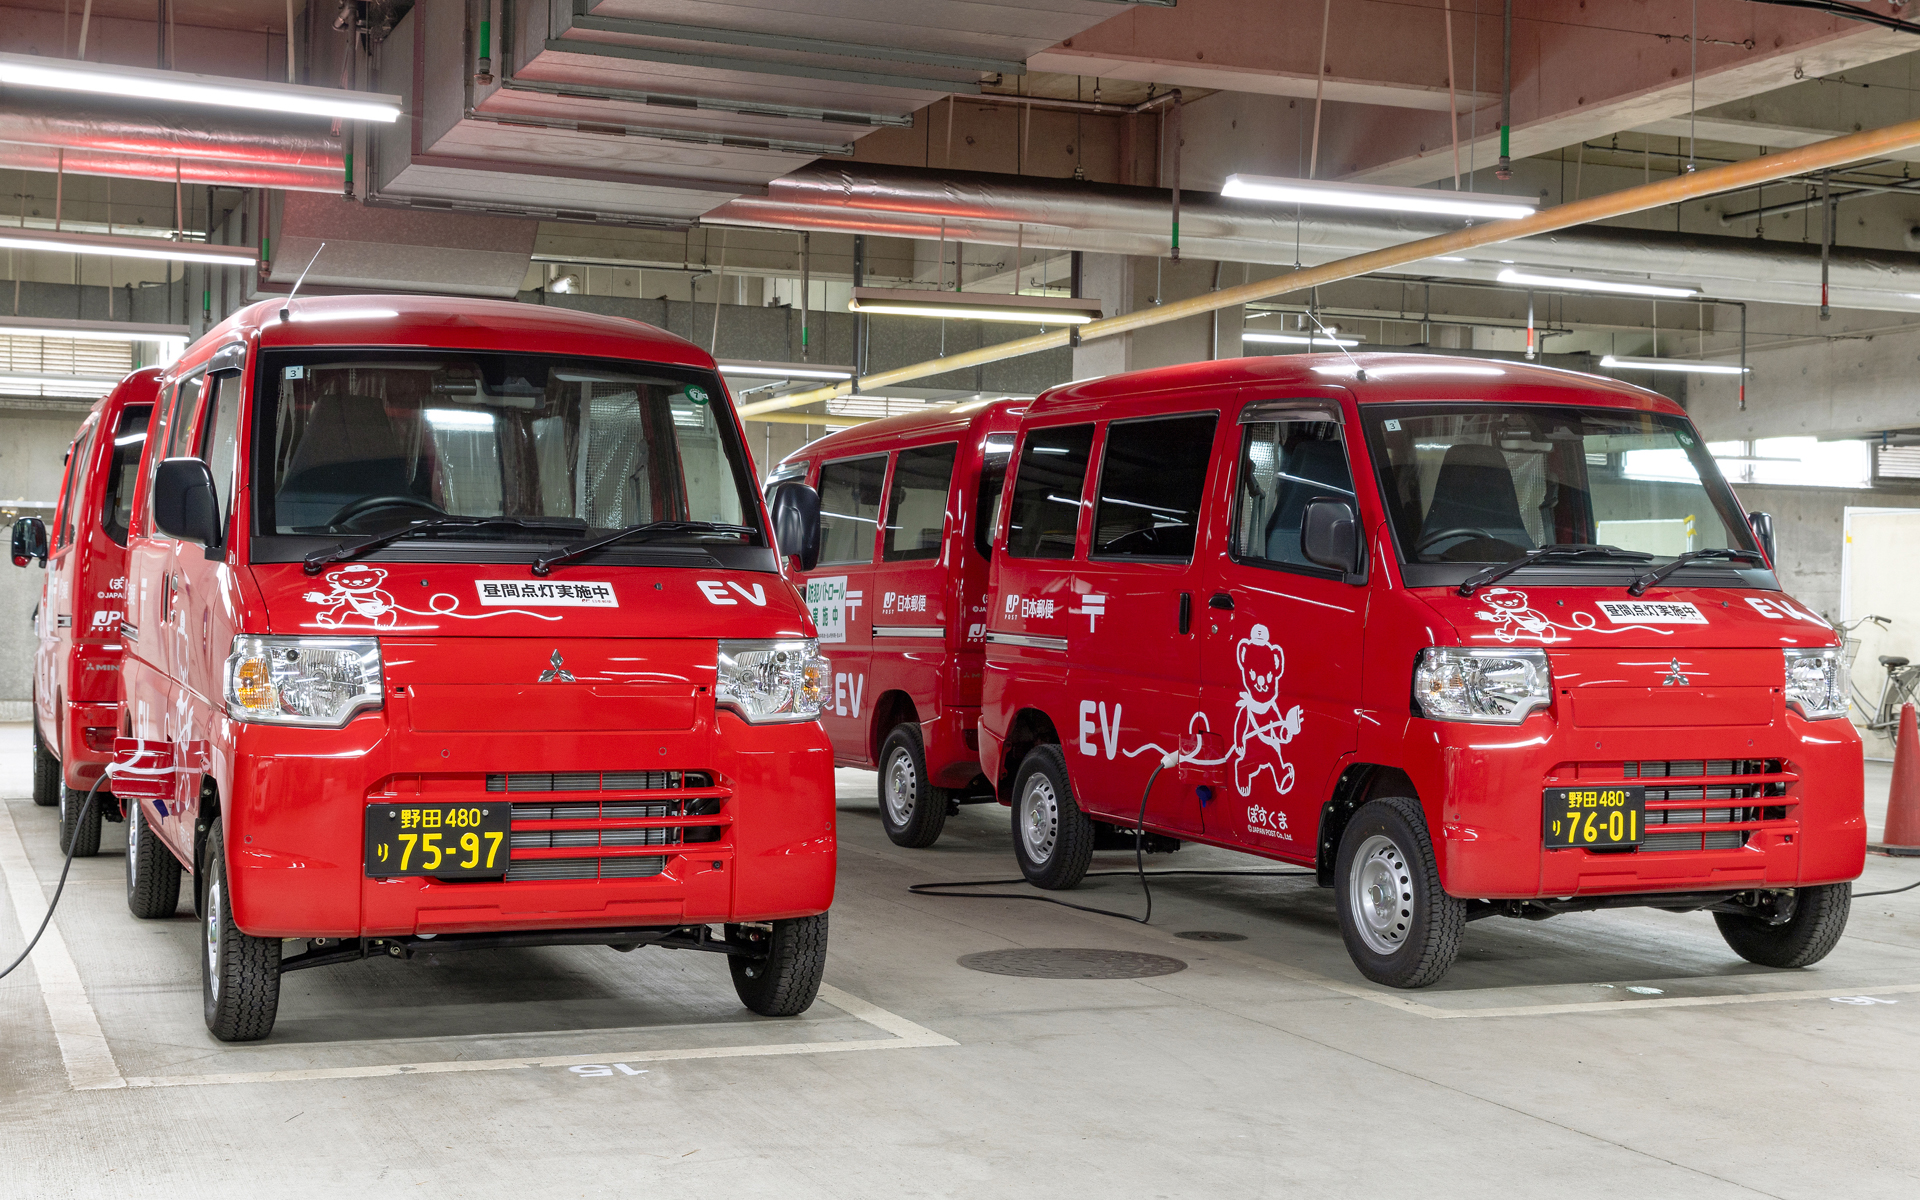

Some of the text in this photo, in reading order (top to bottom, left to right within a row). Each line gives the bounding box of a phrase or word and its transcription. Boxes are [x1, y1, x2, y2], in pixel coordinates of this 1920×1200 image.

[483, 583, 610, 600] 昼間点灯実施中
[696, 580, 767, 607] EV
[808, 582, 845, 603] 防犯パトロール
[897, 594, 927, 613] 日本郵便
[1021, 597, 1054, 620] 日本郵便
[1603, 604, 1697, 617] 昼間点灯実施中
[1744, 597, 1803, 620] EV
[835, 672, 864, 719] EV
[1079, 699, 1122, 761] EV
[1568, 790, 1625, 808] 野田 480
[401, 808, 481, 828] 野田 480
[1247, 804, 1288, 830] ぽすくま
[1552, 810, 1637, 843] り 76-01
[377, 832, 503, 871] り 75-97
[568, 1063, 649, 1077] 15
